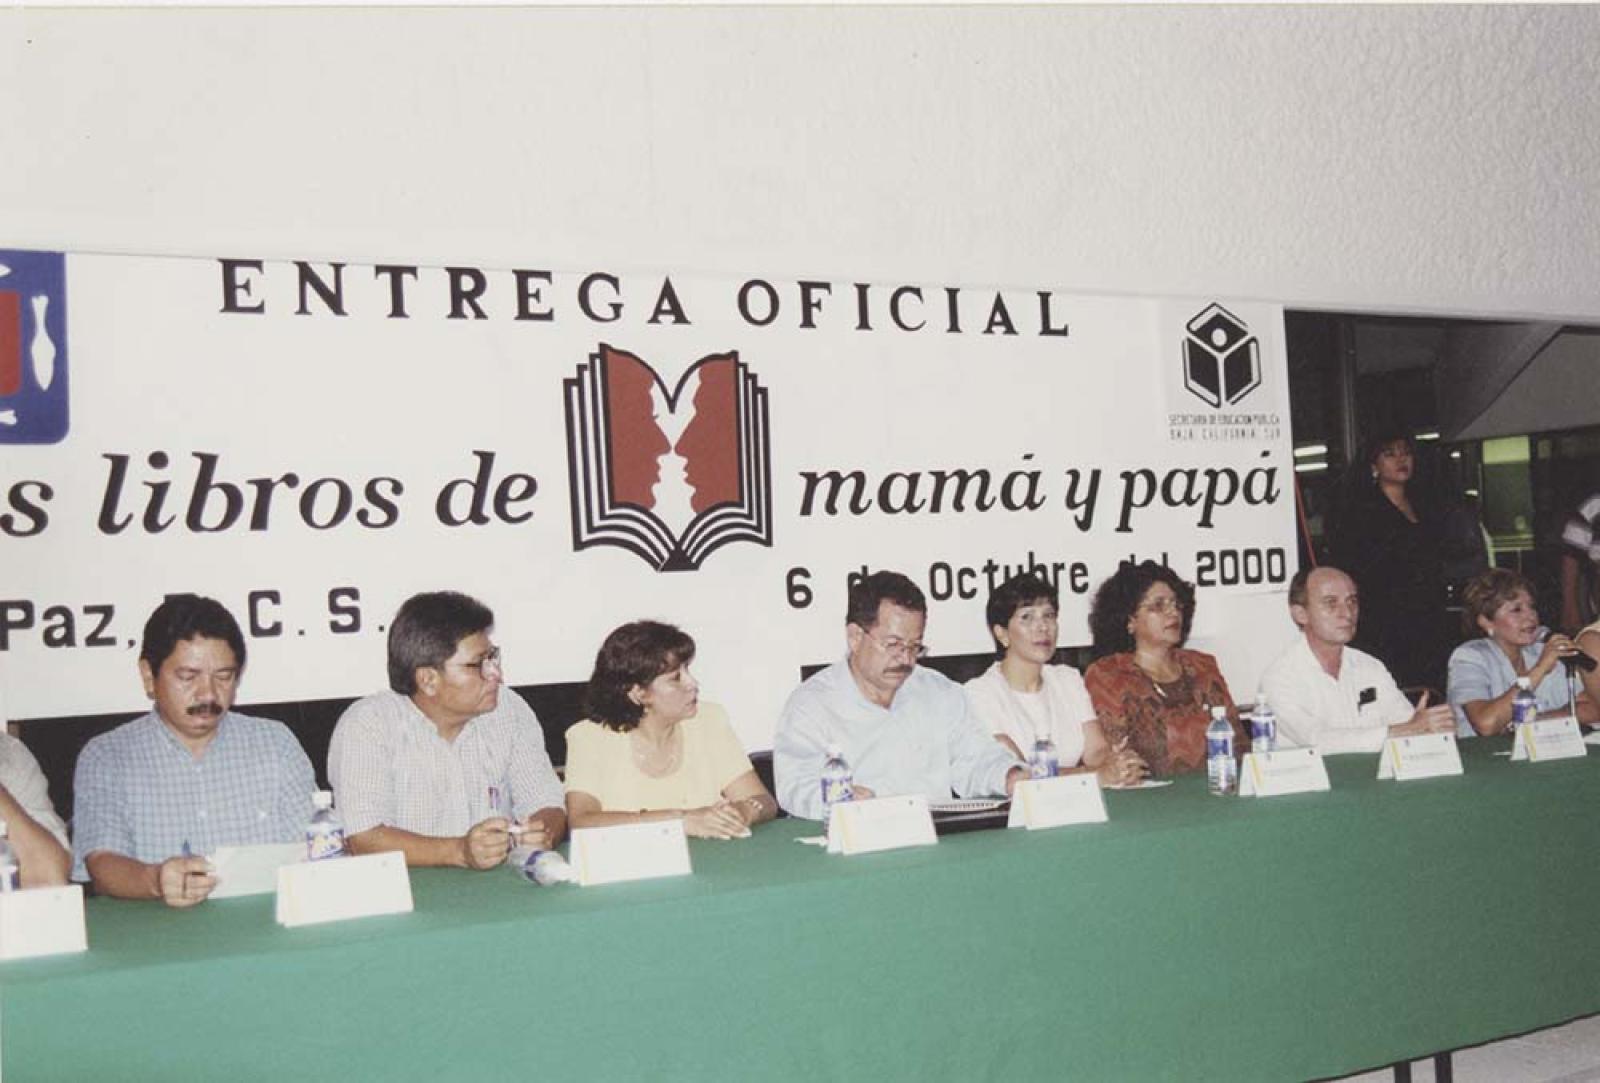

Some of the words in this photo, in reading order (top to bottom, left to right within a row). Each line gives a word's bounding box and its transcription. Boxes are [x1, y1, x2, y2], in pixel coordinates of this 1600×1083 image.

[217, 258, 692, 325] ENTREGA
[737, 279, 1069, 337] OFICIAL
[98, 450, 404, 535] libros
[435, 450, 538, 527] de
[799, 453, 1047, 516] mamá
[1065, 468, 1102, 532] y
[1114, 450, 1281, 534] papá
[786, 567, 813, 609] 6
[1196, 546, 1287, 587] 2000
